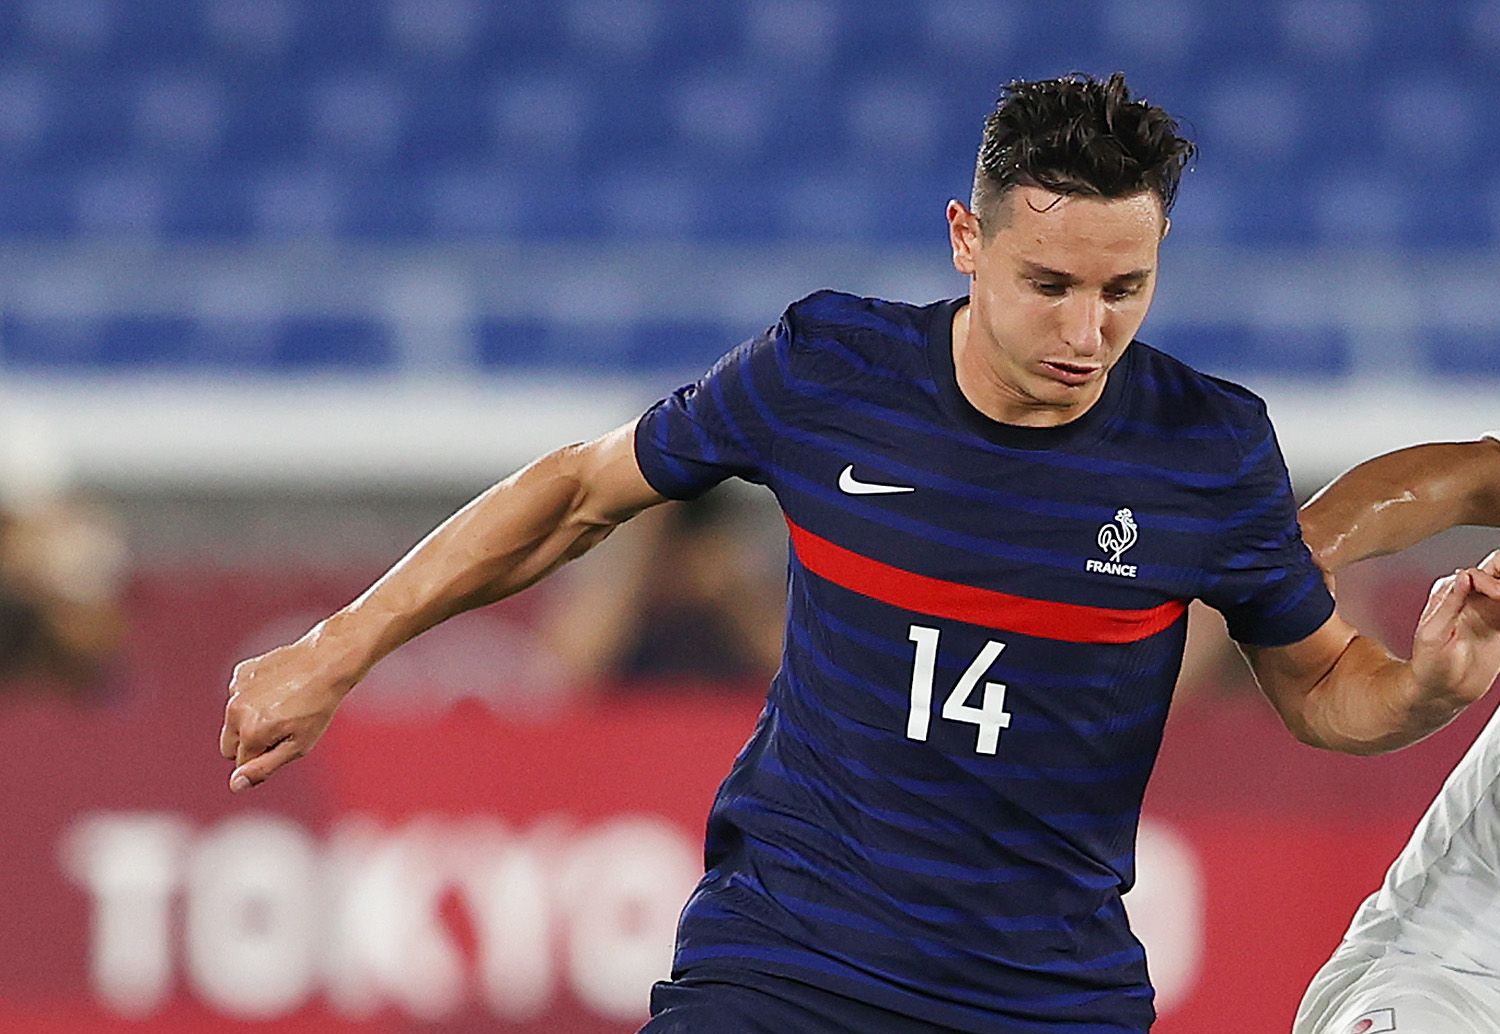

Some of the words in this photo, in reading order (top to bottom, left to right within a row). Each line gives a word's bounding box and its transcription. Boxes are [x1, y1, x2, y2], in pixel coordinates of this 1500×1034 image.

[1085, 559, 1138, 578] FRANCE
[906, 624, 1011, 755] 14
[64, 811, 702, 1018] TOKYO
